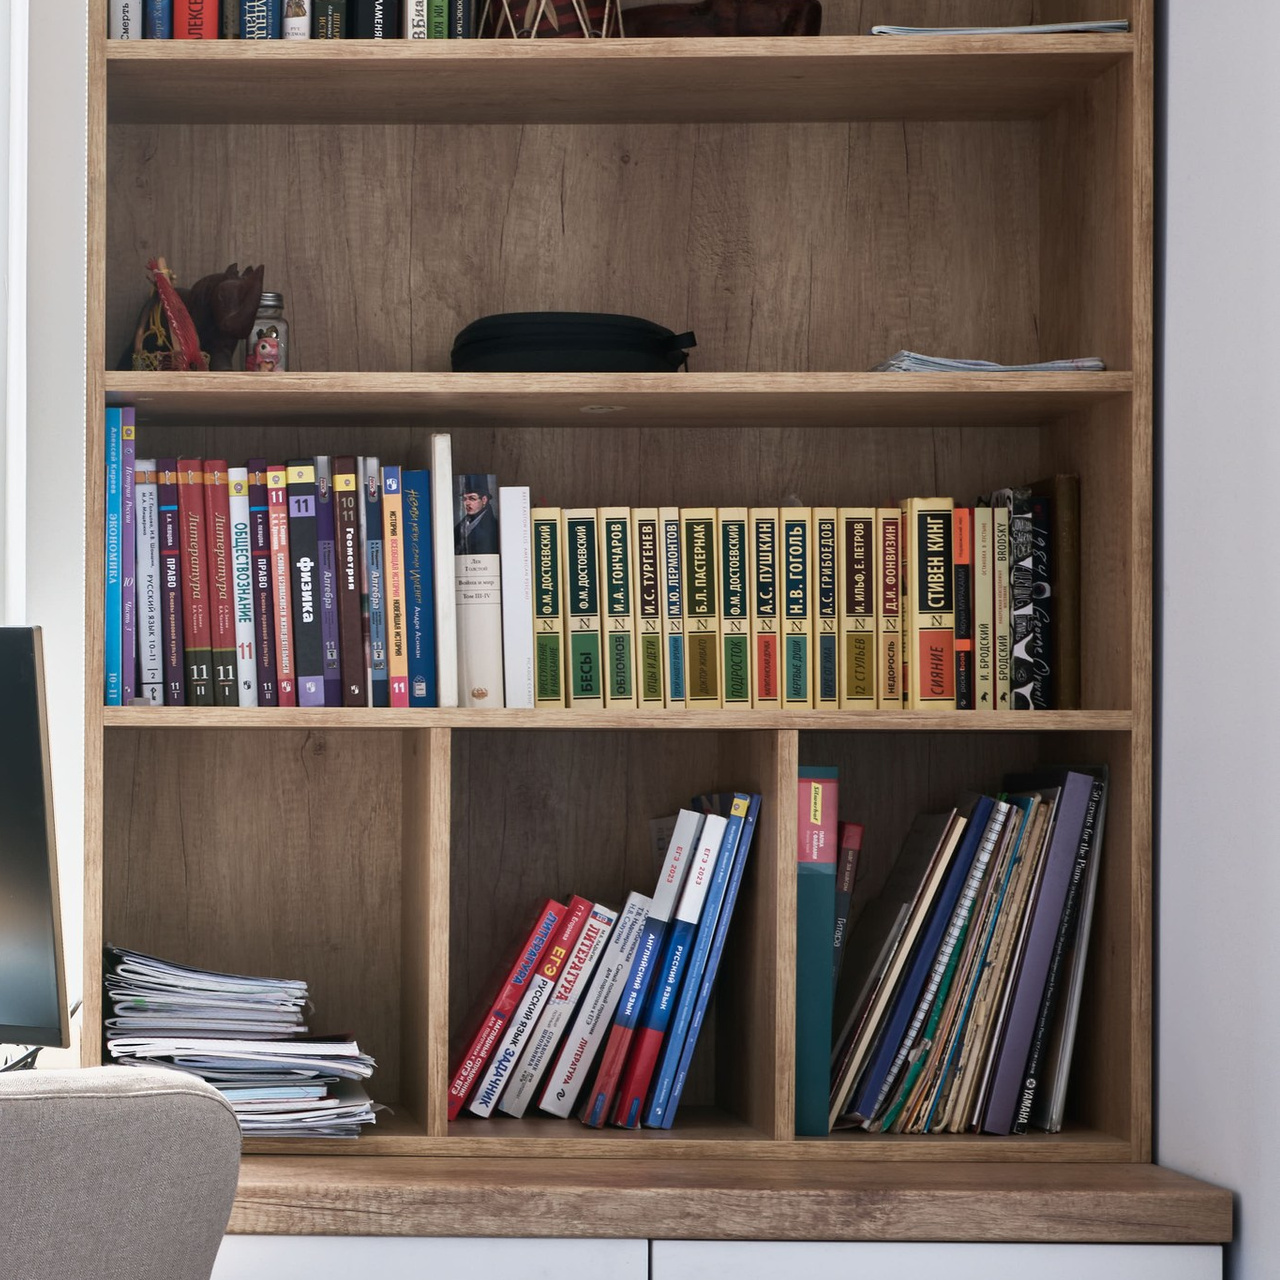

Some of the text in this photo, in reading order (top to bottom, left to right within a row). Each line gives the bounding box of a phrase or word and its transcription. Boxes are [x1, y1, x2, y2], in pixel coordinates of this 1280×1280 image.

[120, 3, 130, 40] Смерть
[433, 5, 444, 18] ИМ
[109, 464, 117, 494] Киреев
[125, 466, 133, 524] История России
[272, 490, 283, 503] 11
[341, 497, 354, 508] 10
[294, 499, 309, 513] 11
[342, 510, 354, 522] 11
[108, 513, 117, 584] ЭКОНОМИКА
[187, 512, 201, 599] Литература
[213, 512, 227, 600] Литература
[346, 527, 355, 590] Геометрия
[575, 525, 590, 609] Ф.М. ДОСТОЕВСКИЙ
[927, 516, 945, 608] СТИВЕН КИНГ
[997, 522, 1007, 562] BRODSKY
[1032, 527, 1049, 577] 1984
[123, 576, 133, 587] 10
[233, 522, 252, 623] ОБЩЕСТВОЗНАНИЕ
[257, 558, 268, 588] ПРАВО
[297, 556, 314, 623] физика
[323, 571, 334, 609] Алгебра
[370, 570, 381, 609] Алгебра
[390, 510, 403, 657] ИСТОРИЯ ВСЕОБЩАЯ ИСТОРИЯ НОВЕЙШАЯ ИСТОРИЯ
[539, 525, 553, 614] Ф.М. ДОСТОЕВСКИЙ
[611, 523, 625, 612] И.А. ГОНЧАРОВ
[642, 524, 655, 613] И.С. ТУРГЕНЕВ
[667, 524, 680, 615] М.Ю. ЛЕРМОНТОВ
[693, 524, 708, 613] Б.Л. ПАСТЕРНАК
[727, 525, 742, 616] Ф.М. ДОСТОЕВСКИЙ
[759, 523, 773, 613] А.С. ПУШКИН
[789, 526, 804, 613] Н.В. ГОГОЛЬ
[821, 523, 834, 615] А.С. ГРИБОЕДОВ
[853, 522, 867, 613] И. ИЛЬФ, Е. ПЕТРОВ
[885, 525, 898, 611] Д.И. ФОНВИЗИН
[958, 567, 966, 610] МУРАКАМИ
[124, 601, 133, 623] Часть
[146, 574, 157, 662] РУССКИЙ ЯЗЫК 10-11
[167, 558, 178, 667] ПРАВО Основы правовой культуры
[413, 606, 422, 658] Андре Асиман
[191, 665, 209, 680] 11
[217, 665, 235, 680] 11
[238, 642, 253, 660] 11
[262, 640, 270, 667] культуры
[539, 642, 549, 695] ПРЕСТУПЛЕНИЕ
[549, 646, 558, 688] НАКАЗАНИЕ
[580, 651, 593, 692] БЕСЫ
[615, 635, 626, 695] ОБЛОМОВ
[646, 640, 657, 662] ДЕТИ
[697, 638, 709, 694] ДОКТОР ЖИВАГО
[731, 640, 744, 698] ПОДРОСТОК
[792, 640, 803, 697] МЕРТВЫЕ ДУШИ
[855, 637, 867, 695] 12 СТУЛЬЕВ
[887, 641, 896, 694] НЕДОРОСЛЬ
[930, 645, 945, 695] СИЯНИЕ
[959, 651, 967, 693] pocketbook
[979, 623, 991, 681] И. БРОДСКИЙ
[997, 634, 1009, 681] БРОДСКИЙ
[171, 682, 180, 690] 11
[393, 683, 405, 693] 11
[647, 670, 658, 693] ОТЦЫ
[1033, 657, 1050, 707] Orwell
[812, 785, 820, 822] Silwerhof
[666, 845, 683, 883] ЕГЭ 2023
[694, 846, 711, 886] ЕГЭ 2023
[1071, 857, 1087, 884] Piano
[512, 910, 558, 987] ЛИТЕРАТУРА
[613, 915, 629, 944] Слаутина
[833, 917, 847, 948] Гитара
[542, 945, 565, 977] ЕГЭ
[555, 924, 600, 1003] ЛИТЕРАТУРА
[624, 933, 655, 1015] АНГЛИЙСКИЙ ЯЗЫК
[659, 945, 683, 1009] РУССКИЙ ЯЗЫК
[523, 978, 548, 1019] РУССКИЙ
[457, 1019, 503, 1097] НАГЛЯДНЫЙ СПРАВОЧНИК
[509, 1020, 526, 1046] ЯЗЫК
[527, 1028, 548, 1066] ШКОЛЬНИКА
[531, 1031, 554, 1071] СПРАВОЧНИК
[451, 1059, 472, 1094] ОГЭ ЕГЭ
[477, 1046, 515, 1107] ЗАДАЧНИК
[562, 1037, 588, 1085] ЛИТЕРАТУРА
[1016, 1087, 1034, 1124] YAMAHA
